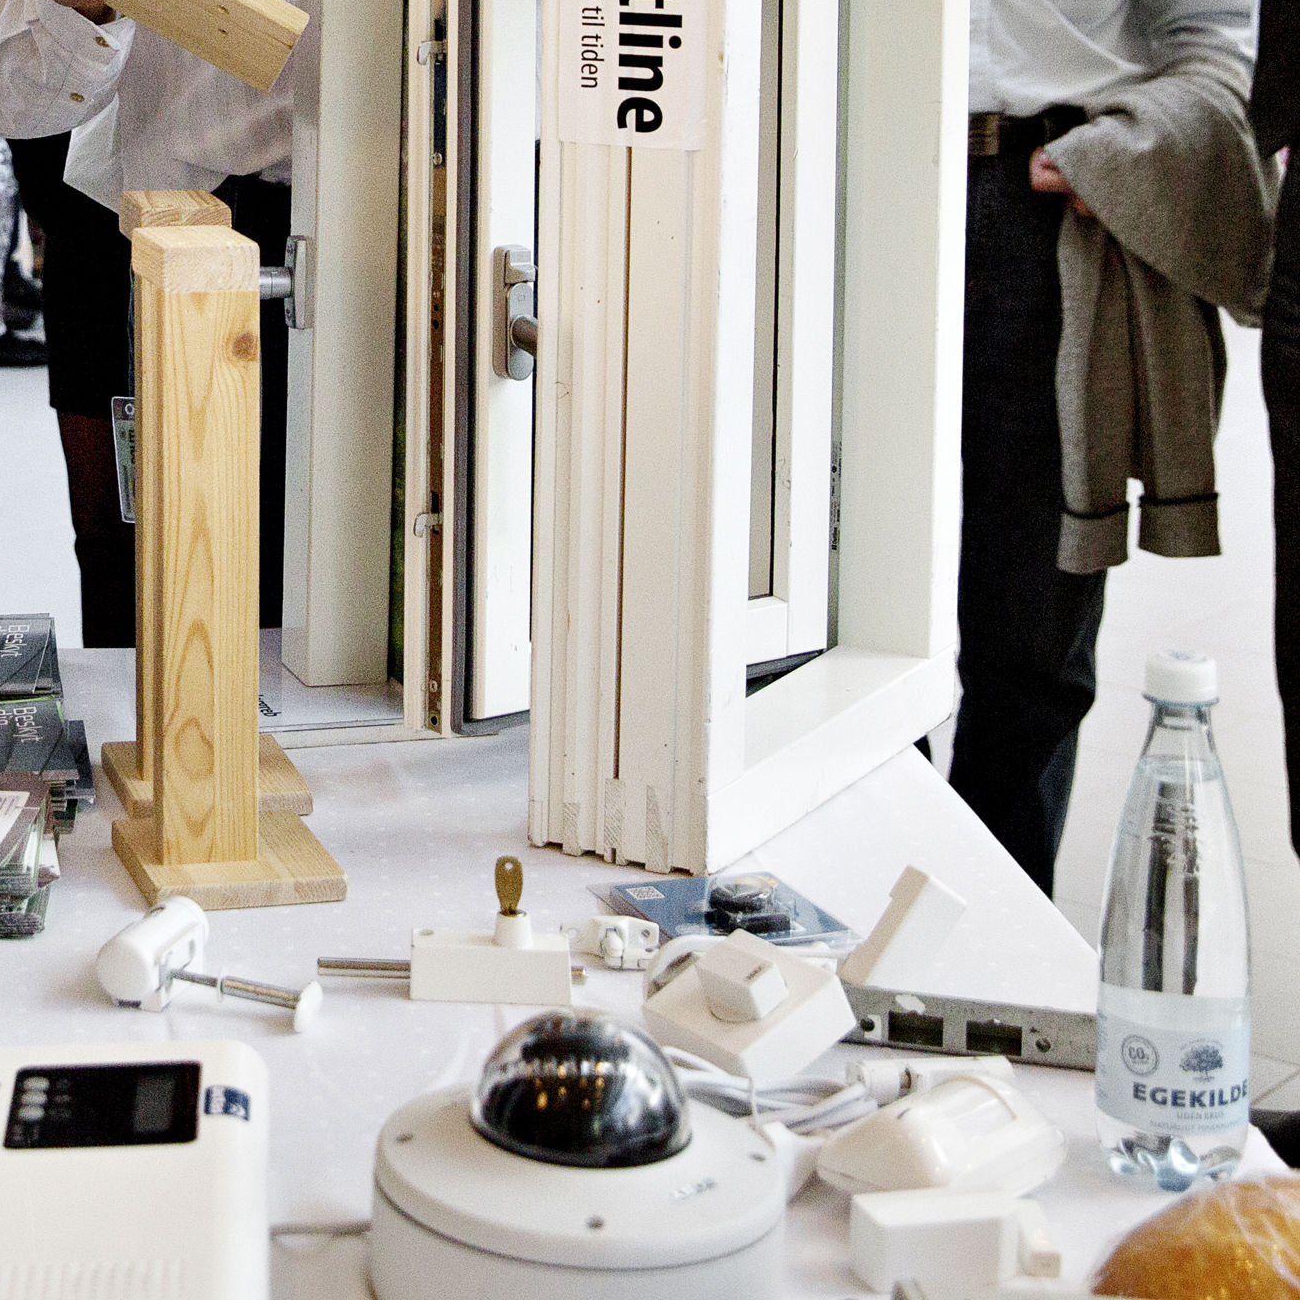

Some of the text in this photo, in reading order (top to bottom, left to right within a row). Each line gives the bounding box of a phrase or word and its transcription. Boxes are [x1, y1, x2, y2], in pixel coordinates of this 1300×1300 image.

[581, 5, 606, 27] til
[580, 33, 605, 89] tiden
[12, 706, 44, 743] Beskyt
[1132, 1078, 1248, 1108] EGEKILDE
